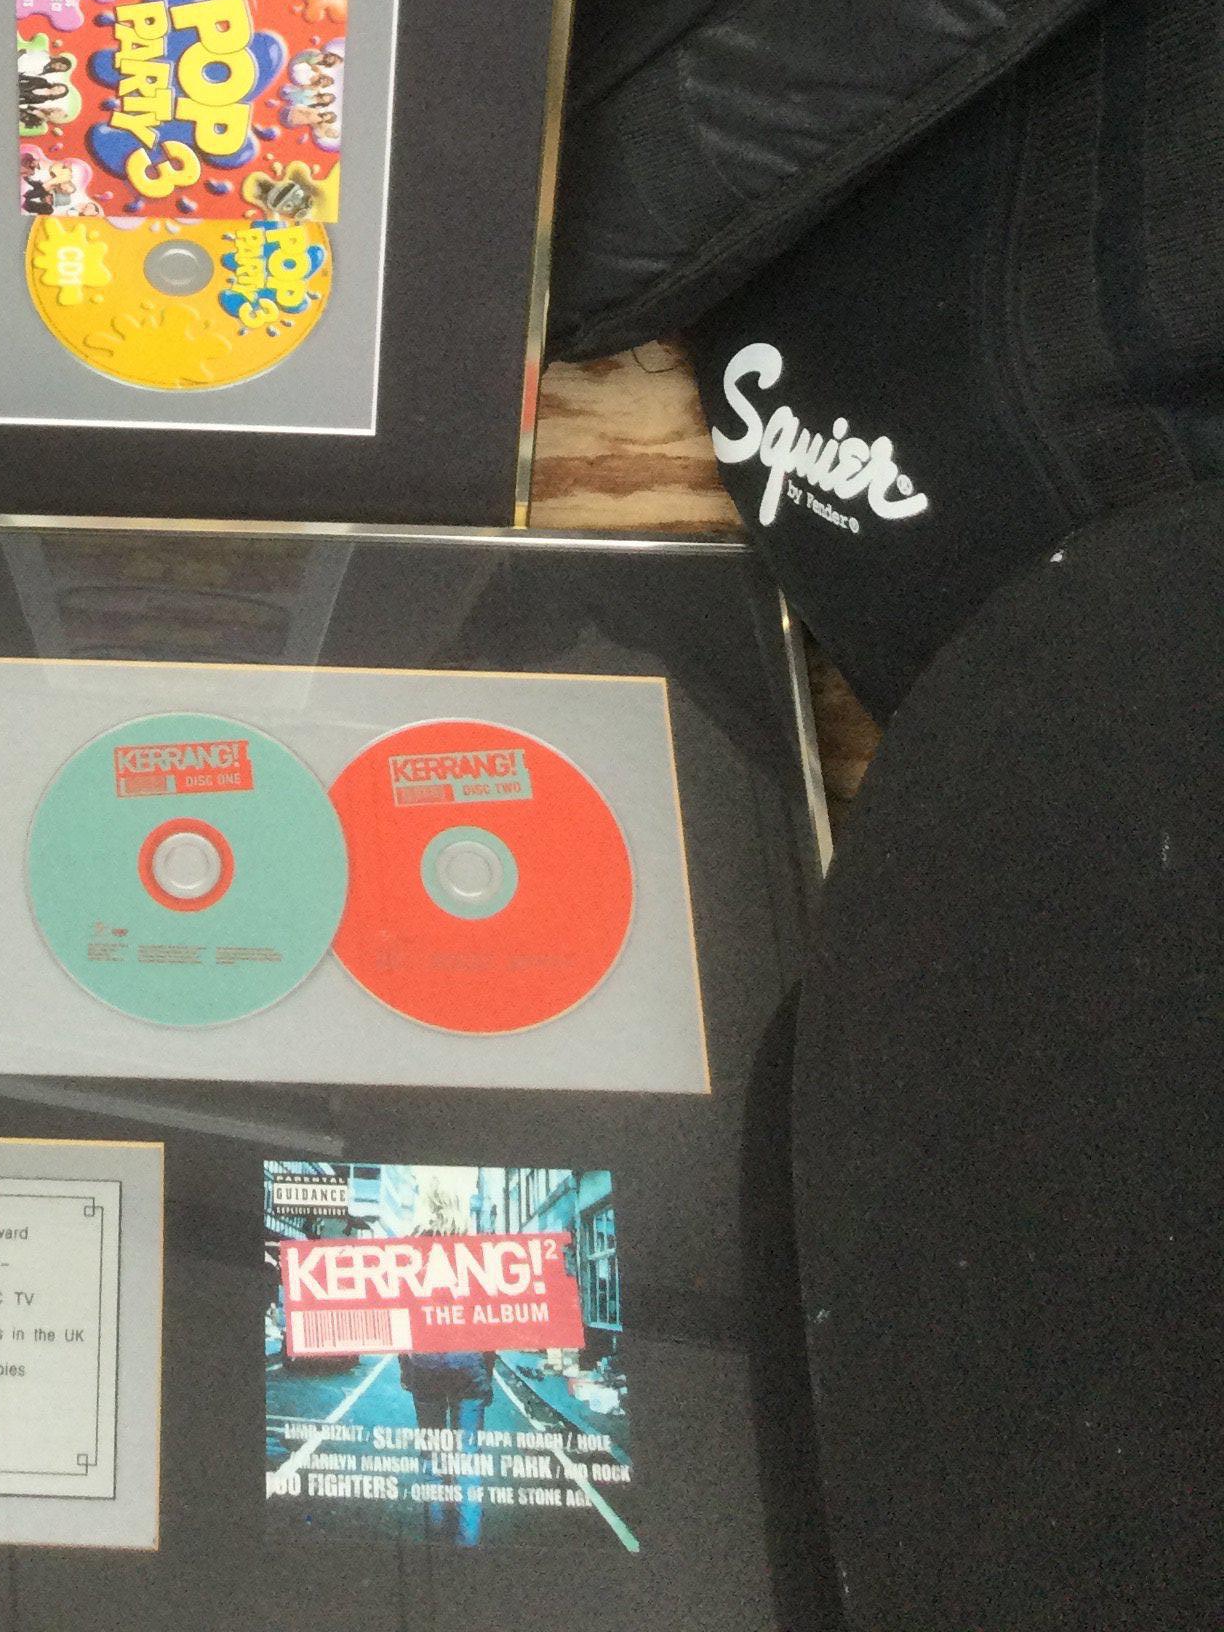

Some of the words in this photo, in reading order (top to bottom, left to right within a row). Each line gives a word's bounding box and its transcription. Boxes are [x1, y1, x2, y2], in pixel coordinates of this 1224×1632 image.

[110, 0, 173, 148] PARTY
[126, 140, 201, 198] 3
[231, 229, 265, 302] PARTY
[266, 226, 311, 306] POP
[239, 298, 279, 328] 3
[712, 343, 927, 526] Squier
[787, 479, 803, 505] by
[117, 743, 240, 773] KERRANG!
[392, 752, 517, 783] KERRANG!
[218, 773, 242, 785] ONE
[496, 781, 522, 794] TWO
[276, 1188, 346, 1202] GUIDANCE
[287, 1239, 546, 1301] KERRANG!
[14, 1291, 35, 1306] TV
[421, 1305, 465, 1326] THE
[472, 1302, 550, 1324] ALBUM
[12, 1327, 25, 1341] in
[34, 1327, 55, 1343] the
[64, 1328, 85, 1343] UK
[373, 1426, 465, 1452] SLIPKNOT
[477, 1430, 513, 1448] PAPA
[516, 1432, 564, 1450] ROACH
[361, 1455, 420, 1473] MANSON
[431, 1452, 494, 1477] LINKIN
[500, 1454, 553, 1479] PARK
[591, 1463, 631, 1482] ROCK
[308, 1472, 399, 1500] FIGHTERS
[410, 1483, 463, 1503] QUEENS
[467, 1485, 485, 1503] OF
[487, 1486, 515, 1504] THE
[518, 1488, 562, 1506] STONE
